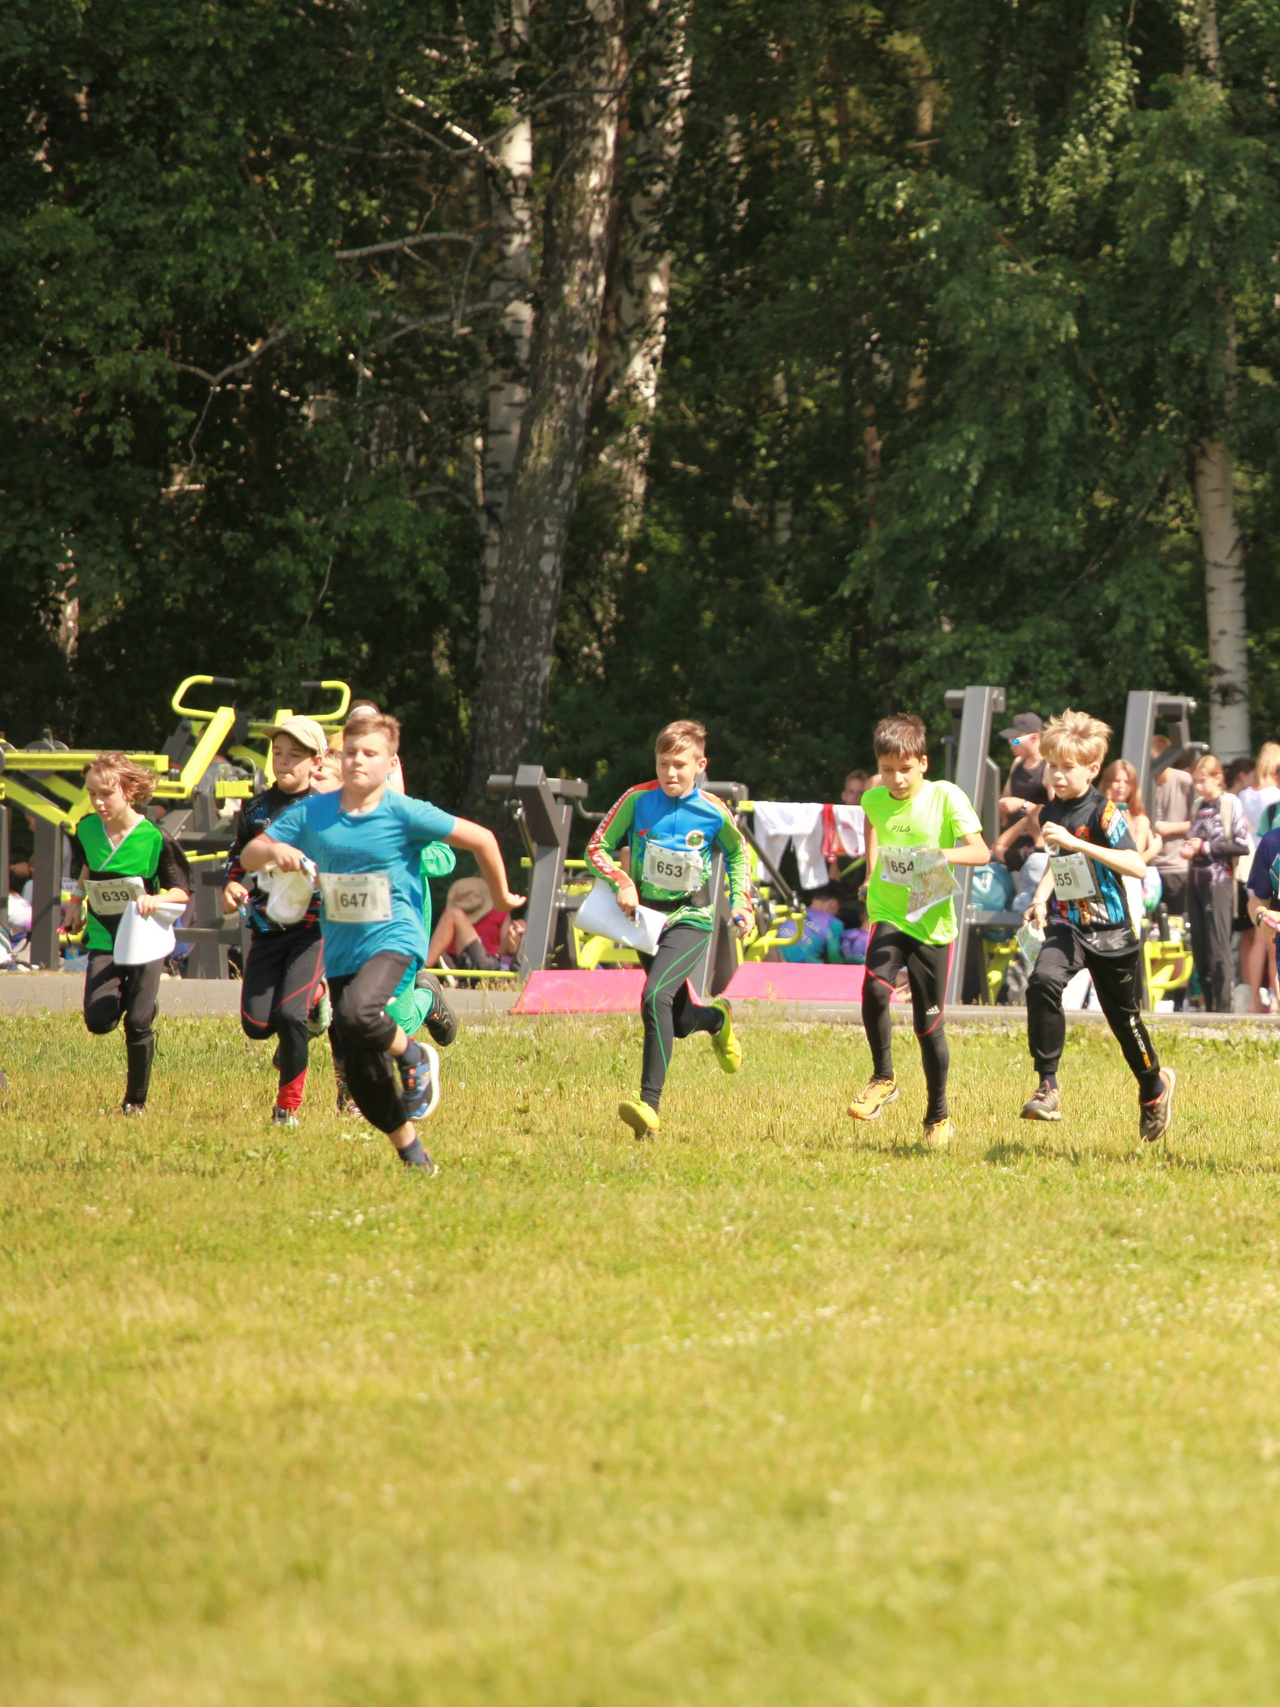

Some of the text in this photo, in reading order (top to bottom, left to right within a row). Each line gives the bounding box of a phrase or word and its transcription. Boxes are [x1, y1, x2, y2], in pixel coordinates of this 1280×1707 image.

[656, 861, 683, 878] 653
[891, 860, 915, 875] 654
[101, 890, 130, 902] 639
[340, 892, 368, 908] 647
